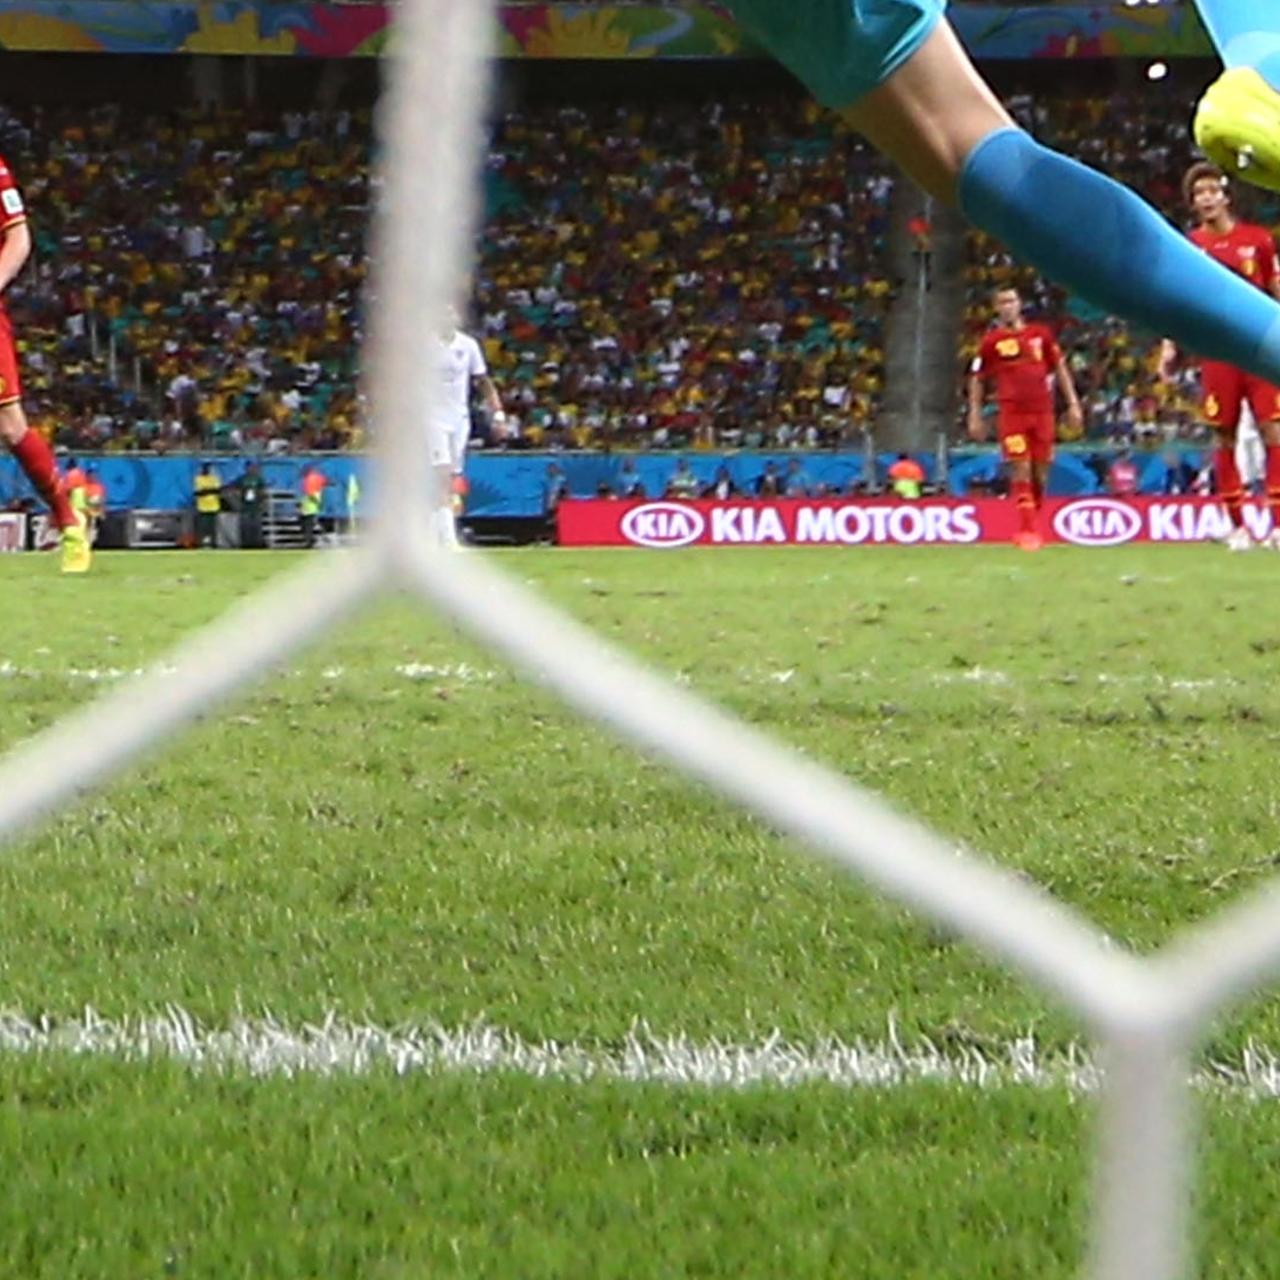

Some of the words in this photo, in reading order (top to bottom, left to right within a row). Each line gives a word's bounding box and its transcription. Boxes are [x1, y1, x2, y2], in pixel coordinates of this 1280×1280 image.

[710, 506, 787, 542] KIA
[794, 505, 981, 543] MOTORS
[1148, 503, 1234, 540] KIA
